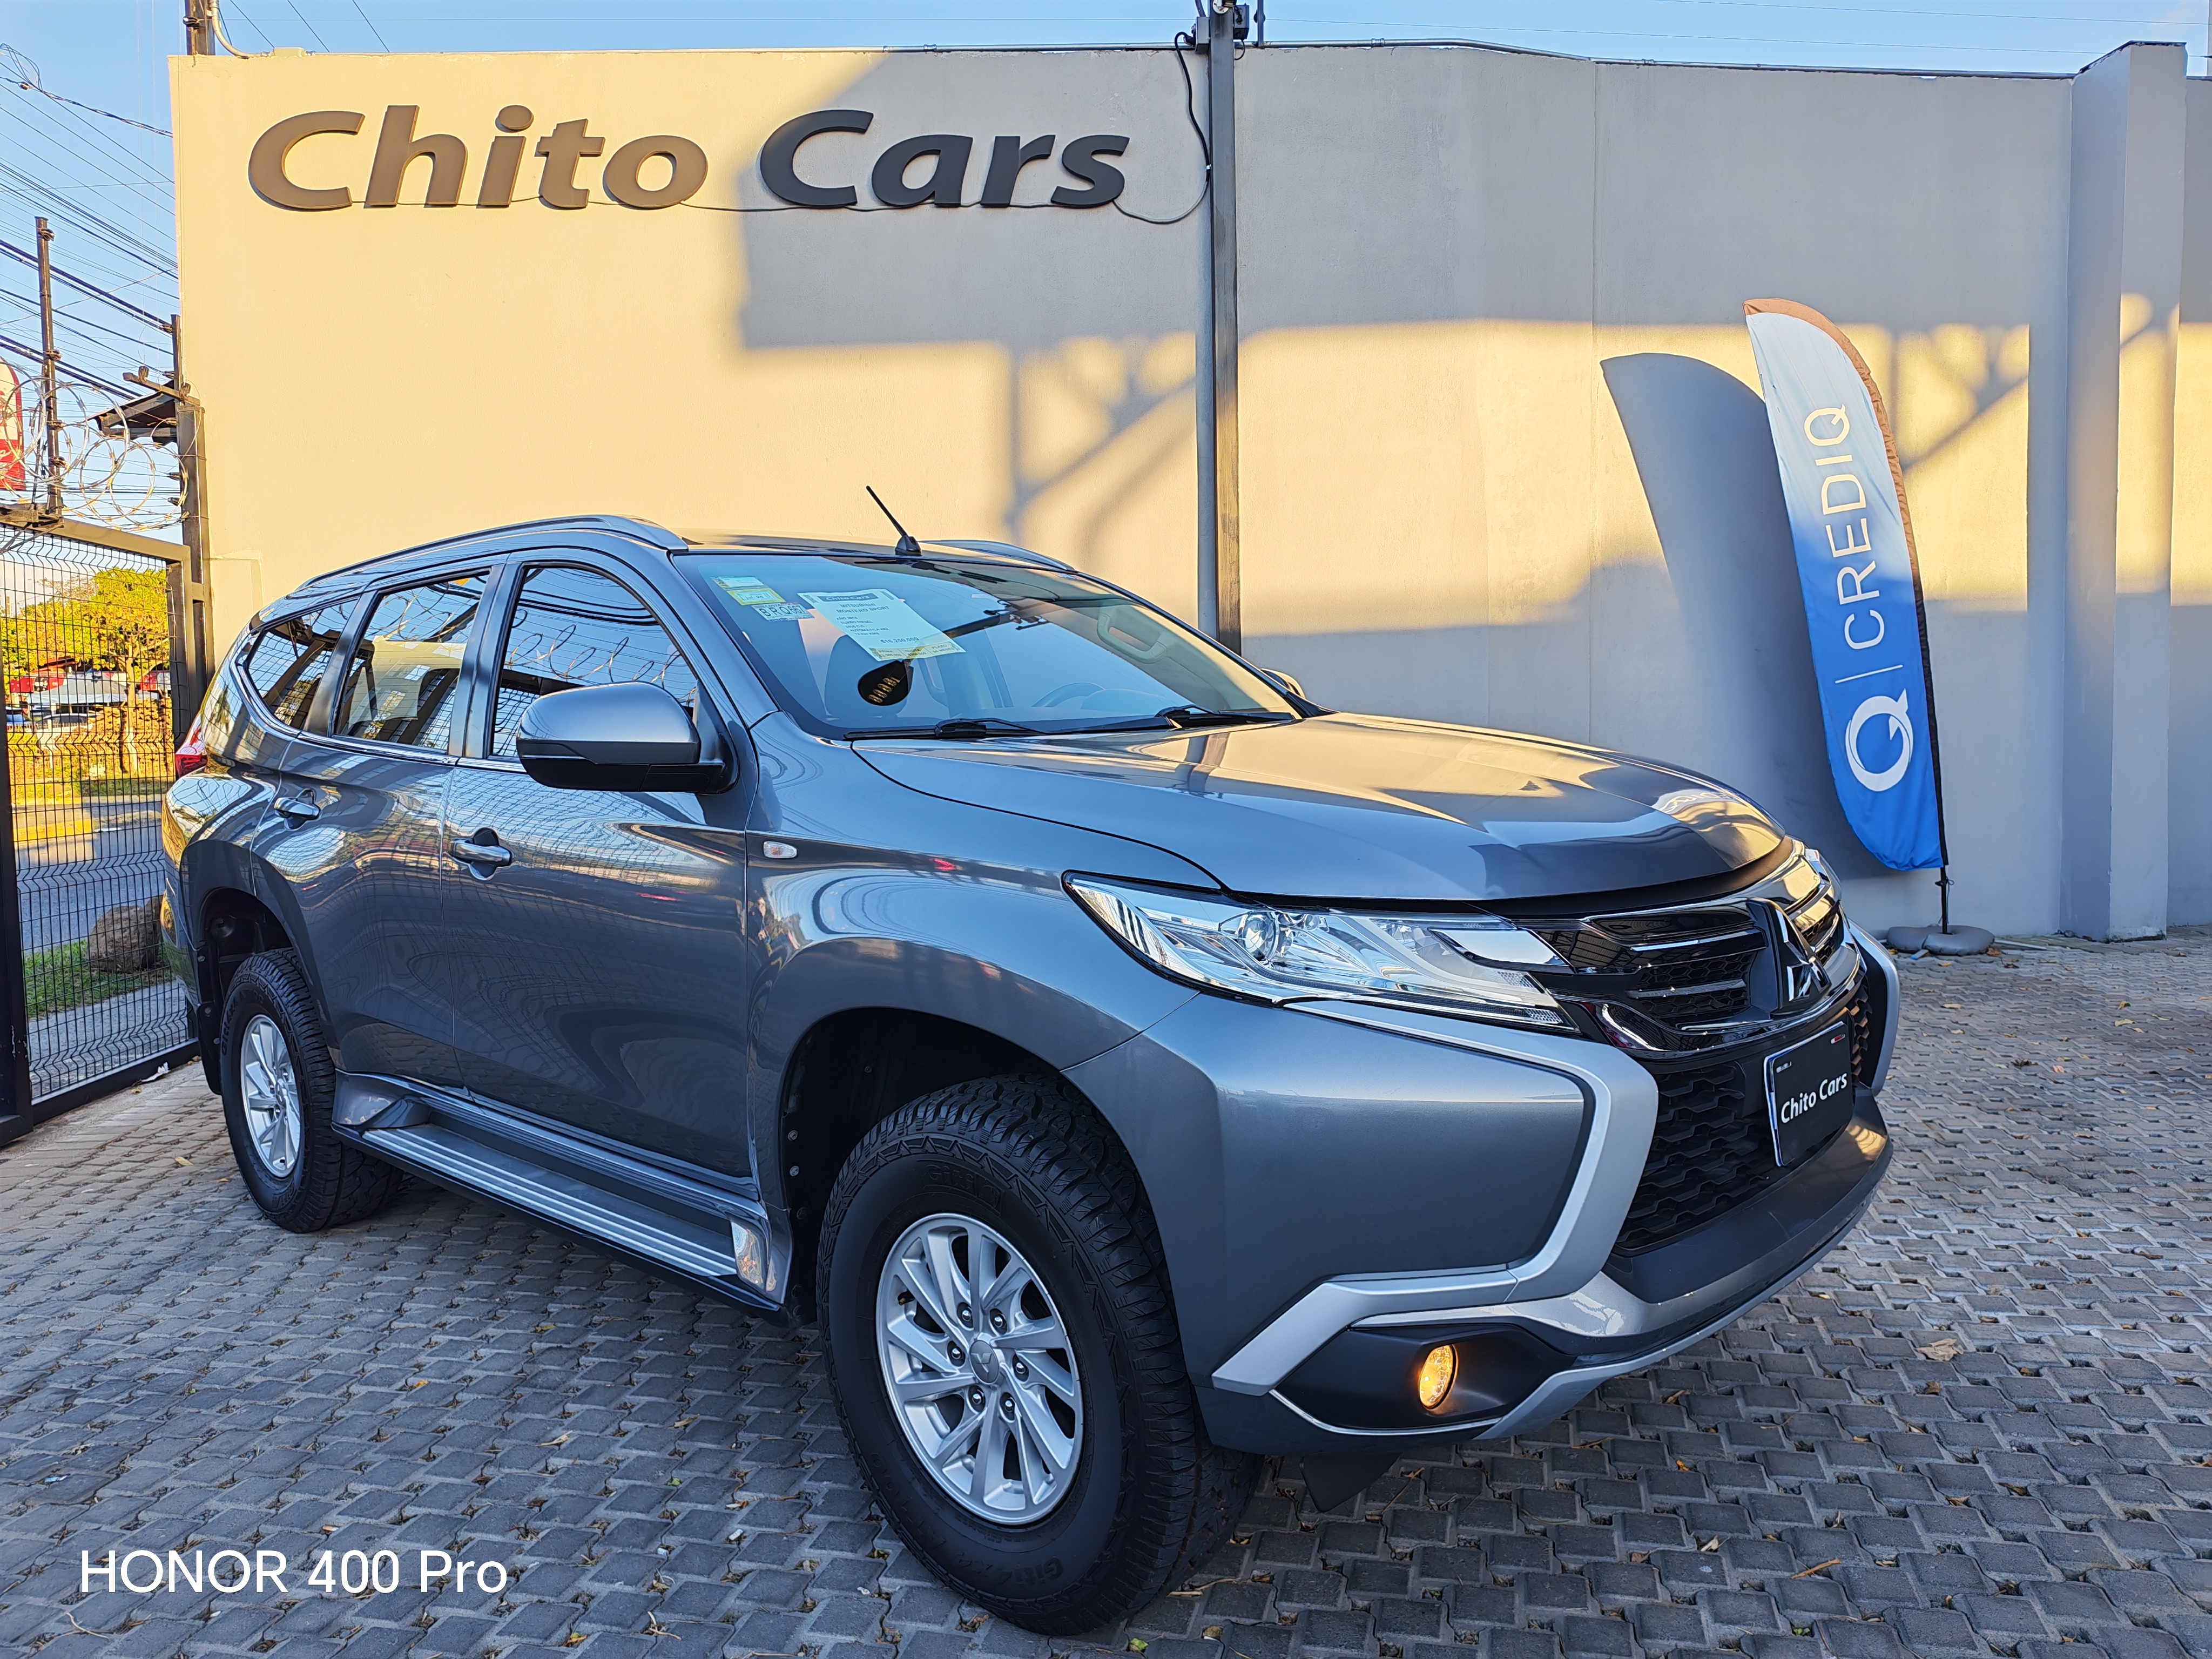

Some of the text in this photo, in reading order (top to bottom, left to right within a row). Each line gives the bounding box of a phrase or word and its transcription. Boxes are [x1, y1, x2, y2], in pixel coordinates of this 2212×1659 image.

[248, 104, 1130, 210] Chito Cars
[1804, 403, 1914, 791] Q CREDIQ
[1781, 1073, 1847, 1124] Chito Cars
[1014, 1556, 1064, 1588] Giti
